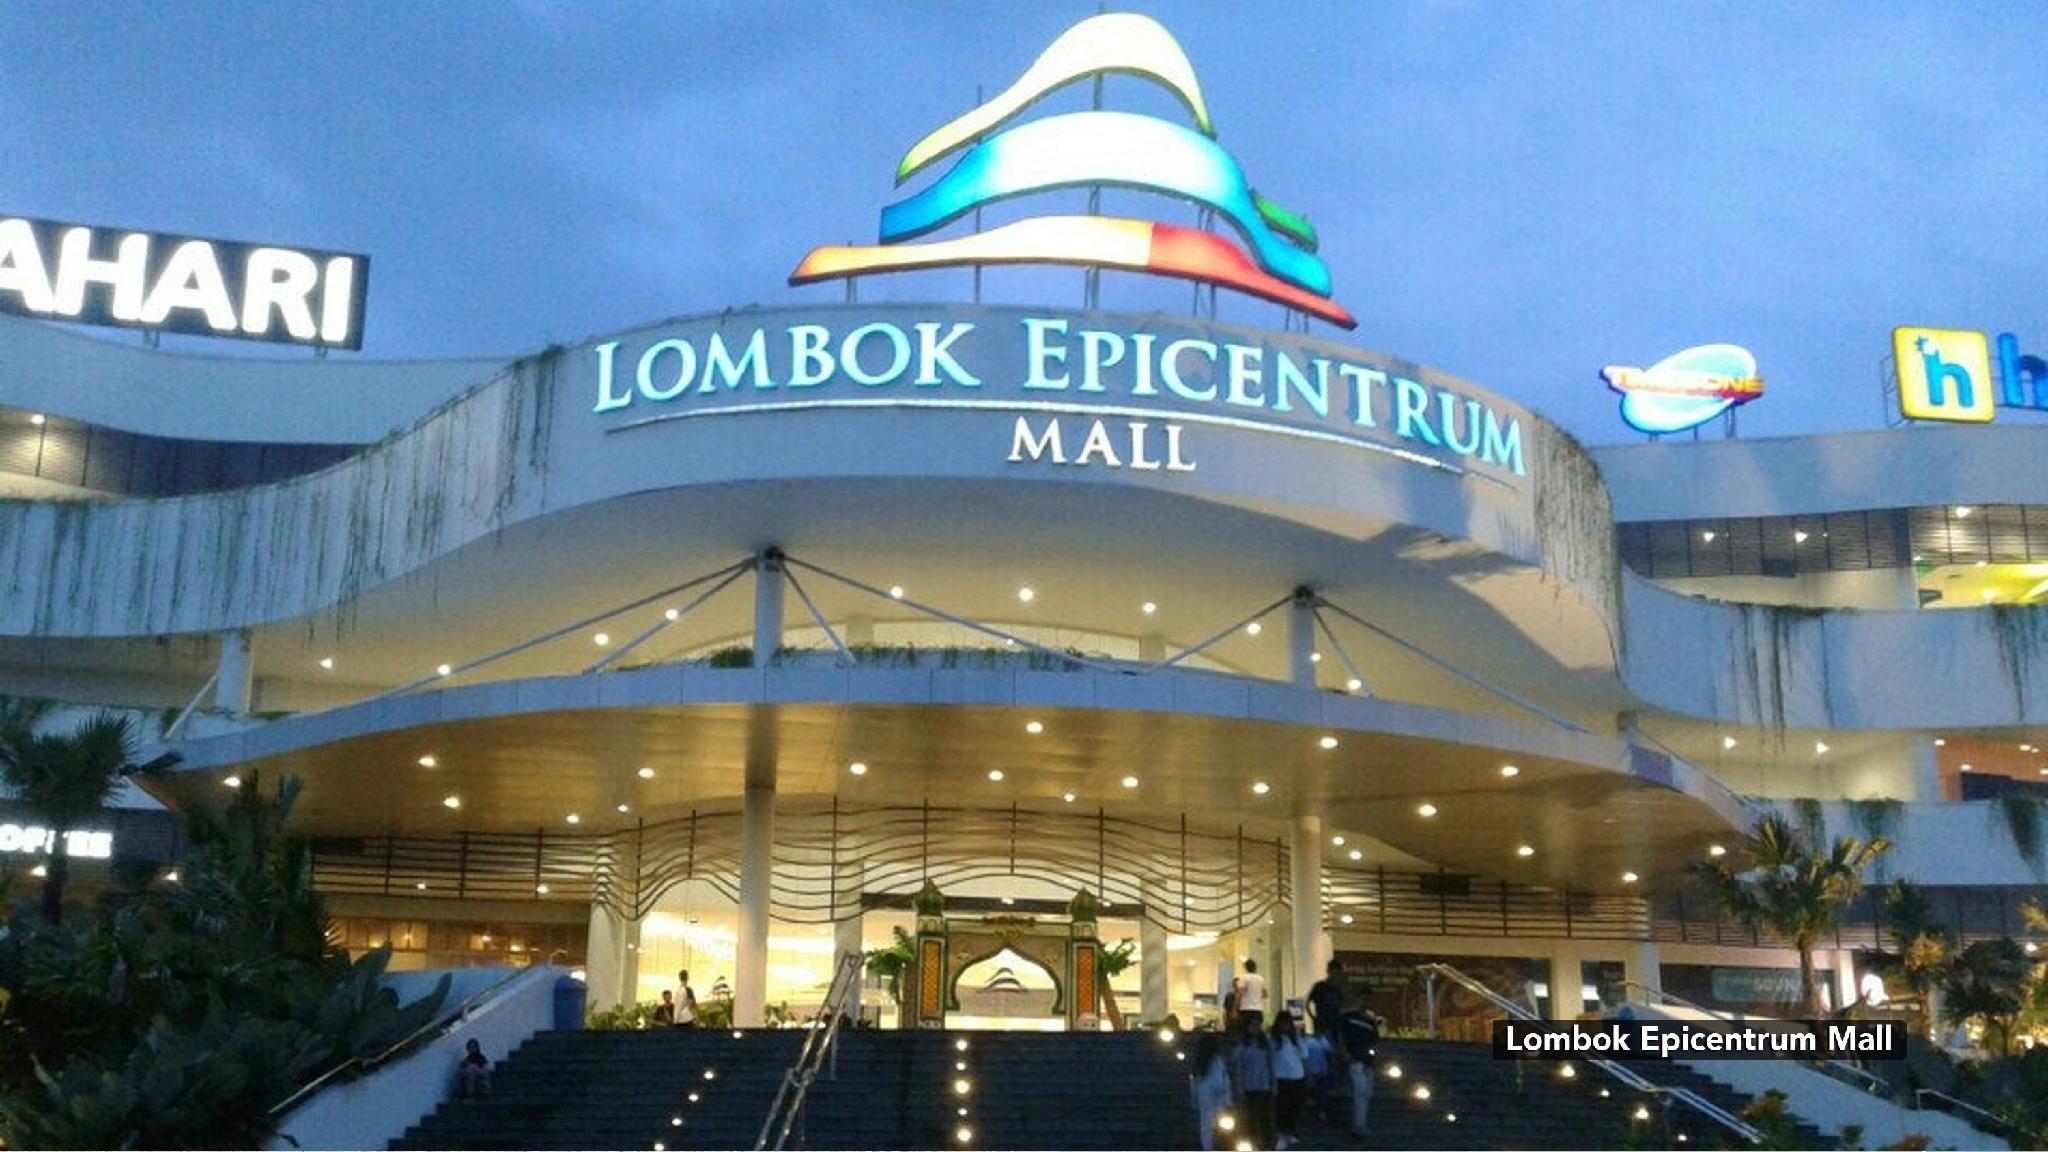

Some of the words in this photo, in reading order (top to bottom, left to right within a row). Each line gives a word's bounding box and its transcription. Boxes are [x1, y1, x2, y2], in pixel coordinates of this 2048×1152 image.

[0, 218, 353, 342] AHARI
[593, 322, 982, 413] LOMBOK
[1021, 317, 1527, 477] EPICENTRUM
[1007, 415, 1197, 472] MALL
